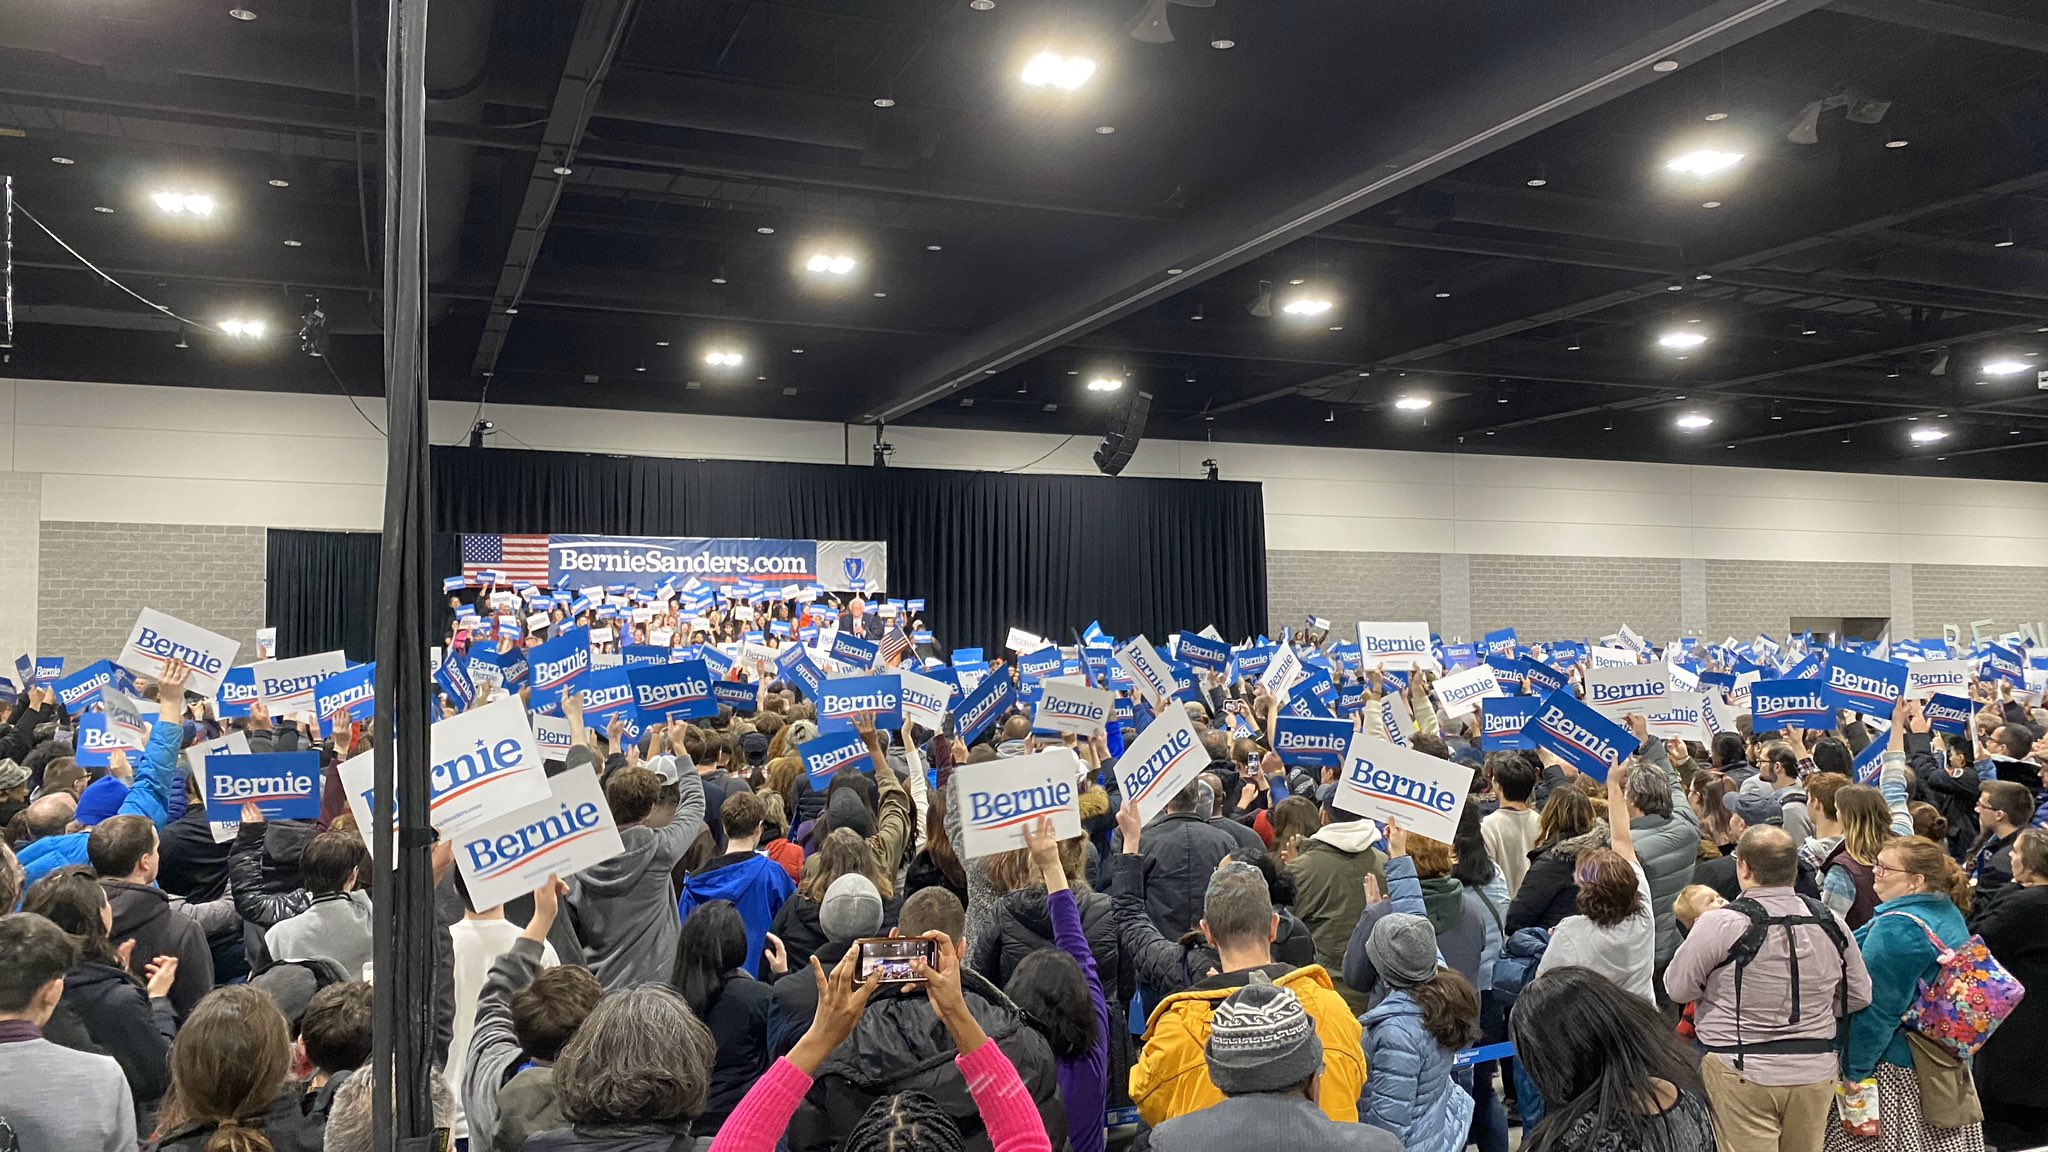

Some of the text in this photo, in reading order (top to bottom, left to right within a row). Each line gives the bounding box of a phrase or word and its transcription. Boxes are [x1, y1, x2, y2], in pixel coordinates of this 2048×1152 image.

[559, 549, 807, 574] BernieSanders.com
[135, 627, 222, 674] Bernie
[822, 635, 834, 643] Ber
[836, 640, 873, 660] Bernie
[1181, 640, 1226, 661] Bernie
[1367, 636, 1425, 652] Bernie
[1489, 637, 1517, 651] Bernie
[1620, 630, 1641, 652] Bernie
[469, 657, 500, 673] Bern
[534, 647, 588, 684] Bernie
[745, 650, 775, 662] Bernie
[1022, 659, 1060, 674] Bernie
[1239, 655, 1267, 667] Bernie
[1341, 652, 1360, 661] Bern
[1992, 653, 2022, 677] Bernie
[36, 666, 61, 677] Bernie
[448, 658, 473, 701] Bernie
[502, 658, 528, 681] Bernie
[1128, 645, 1167, 696] Bernie
[1268, 653, 1294, 690] Bernie
[1528, 668, 1561, 689] ernie
[1911, 670, 1963, 685] Bernie
[59, 672, 111, 703] Bernie
[223, 683, 257, 699] Ber
[637, 677, 707, 704] Bernie
[714, 687, 753, 701] Bernie
[1312, 679, 1330, 695] nie
[1442, 677, 1494, 703] Bernie
[1592, 679, 1665, 699] Bernie
[1829, 665, 1899, 700] Bernie
[823, 690, 896, 713] Bernie
[902, 688, 942, 712] ernie
[958, 681, 1008, 732] Bernie
[1044, 696, 1103, 720] Bernie
[1341, 694, 1363, 705] Bern
[1702, 696, 1724, 735] Bern
[1926, 702, 1971, 721] Bernie
[537, 728, 571, 744] Bern
[1278, 731, 1346, 751] Bernie
[1540, 705, 1619, 763] Bernie
[1124, 728, 1191, 801] Bernie
[213, 771, 312, 797] Bernie
[1350, 758, 1455, 812] Bernie
[969, 778, 1071, 821] Bernie
[465, 801, 600, 873] Bernie
